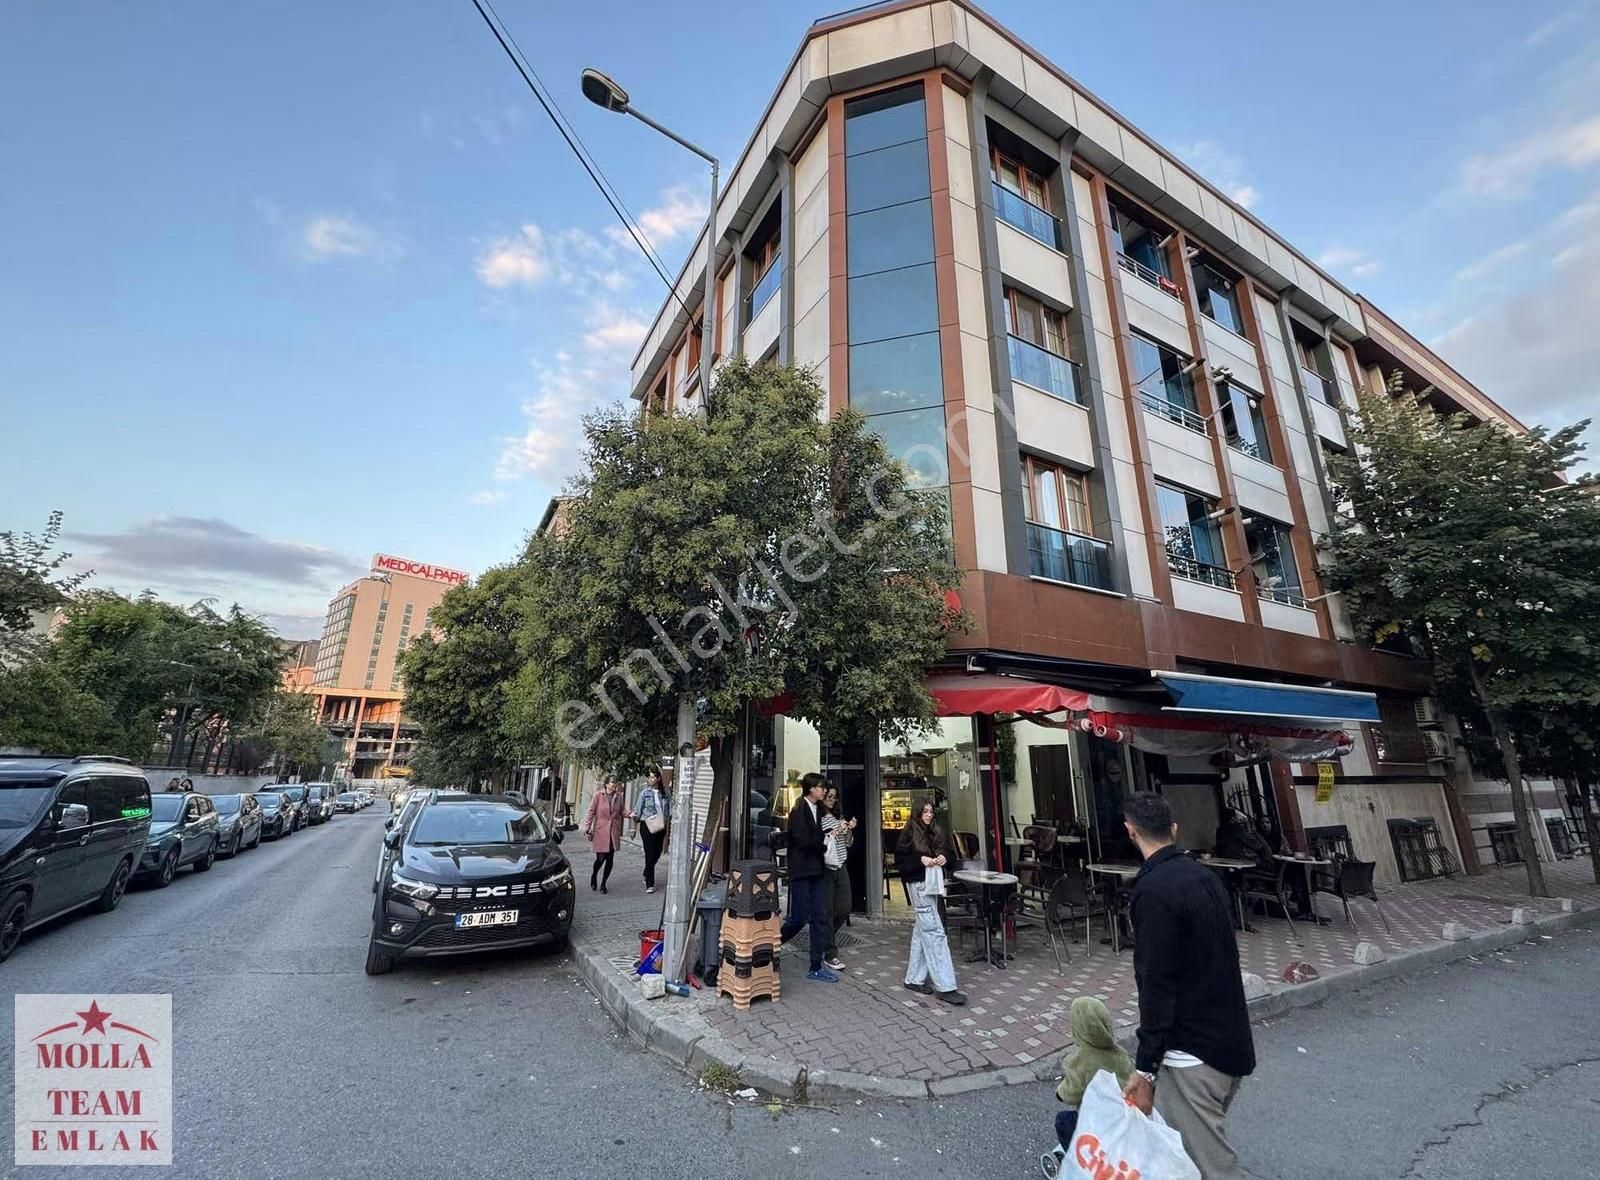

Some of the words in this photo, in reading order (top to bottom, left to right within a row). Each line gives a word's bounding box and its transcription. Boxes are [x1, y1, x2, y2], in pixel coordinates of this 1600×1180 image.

[461, 915, 473, 926] 28
[478, 913, 496, 924] ADM
[501, 911, 517, 922] 351
